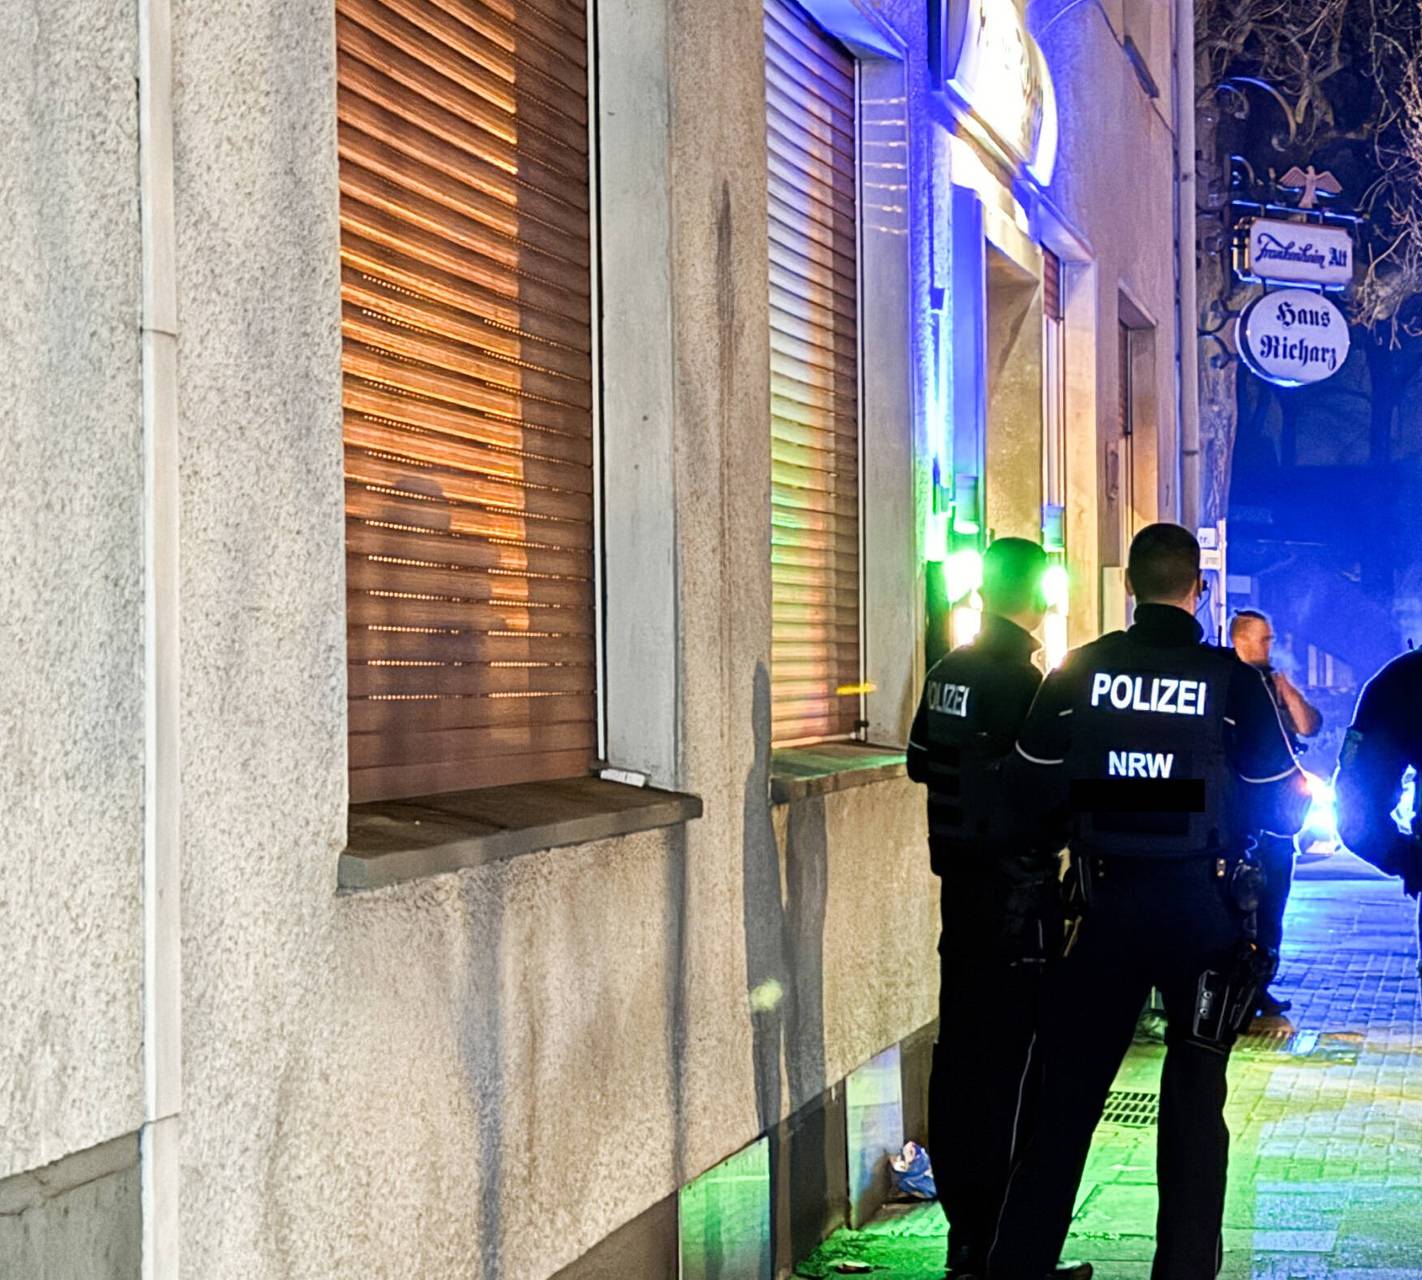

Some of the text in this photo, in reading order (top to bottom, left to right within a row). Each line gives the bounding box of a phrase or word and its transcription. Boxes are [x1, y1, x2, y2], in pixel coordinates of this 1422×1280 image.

[1329, 247, 1347, 267] Alt
[1276, 302, 1331, 328] Haus
[1260, 335, 1337, 370] Richarz
[927, 680, 970, 717] OLIZEI
[1091, 673, 1206, 715] POLIZEI
[1108, 750, 1173, 778] NRW
